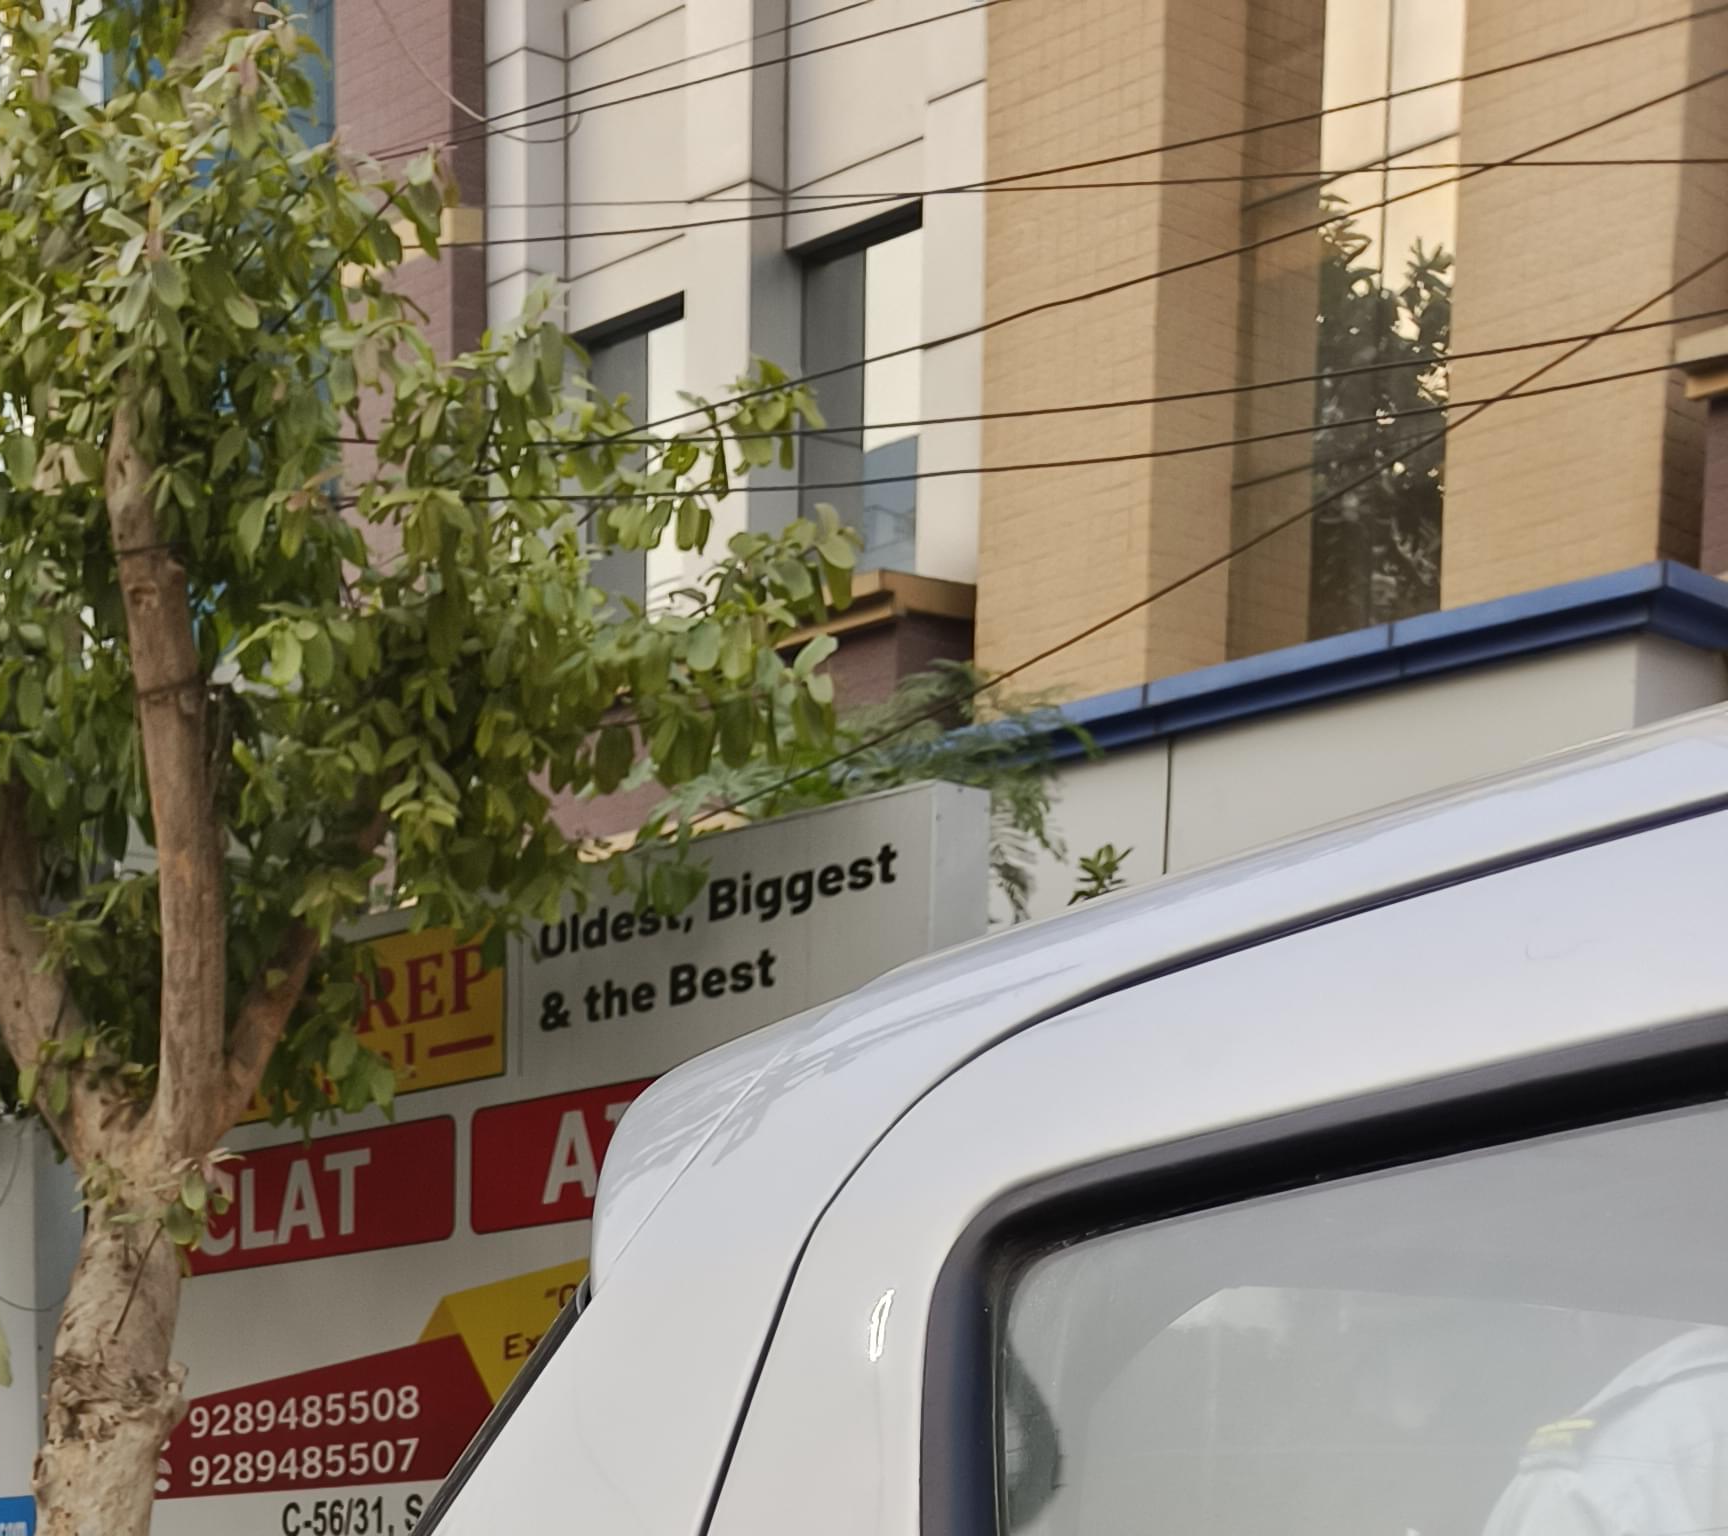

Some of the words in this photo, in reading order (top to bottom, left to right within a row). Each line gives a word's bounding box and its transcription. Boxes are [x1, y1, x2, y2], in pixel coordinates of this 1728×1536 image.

[708, 844, 897, 923] Biggest
[539, 990, 571, 1032] &
[583, 979, 656, 1023] the
[669, 948, 776, 1006] Best
[199, 1148, 371, 1257] CLAT
[189, 1384, 422, 1439] 9289485508
[189, 1436, 421, 1488] 9289485507
